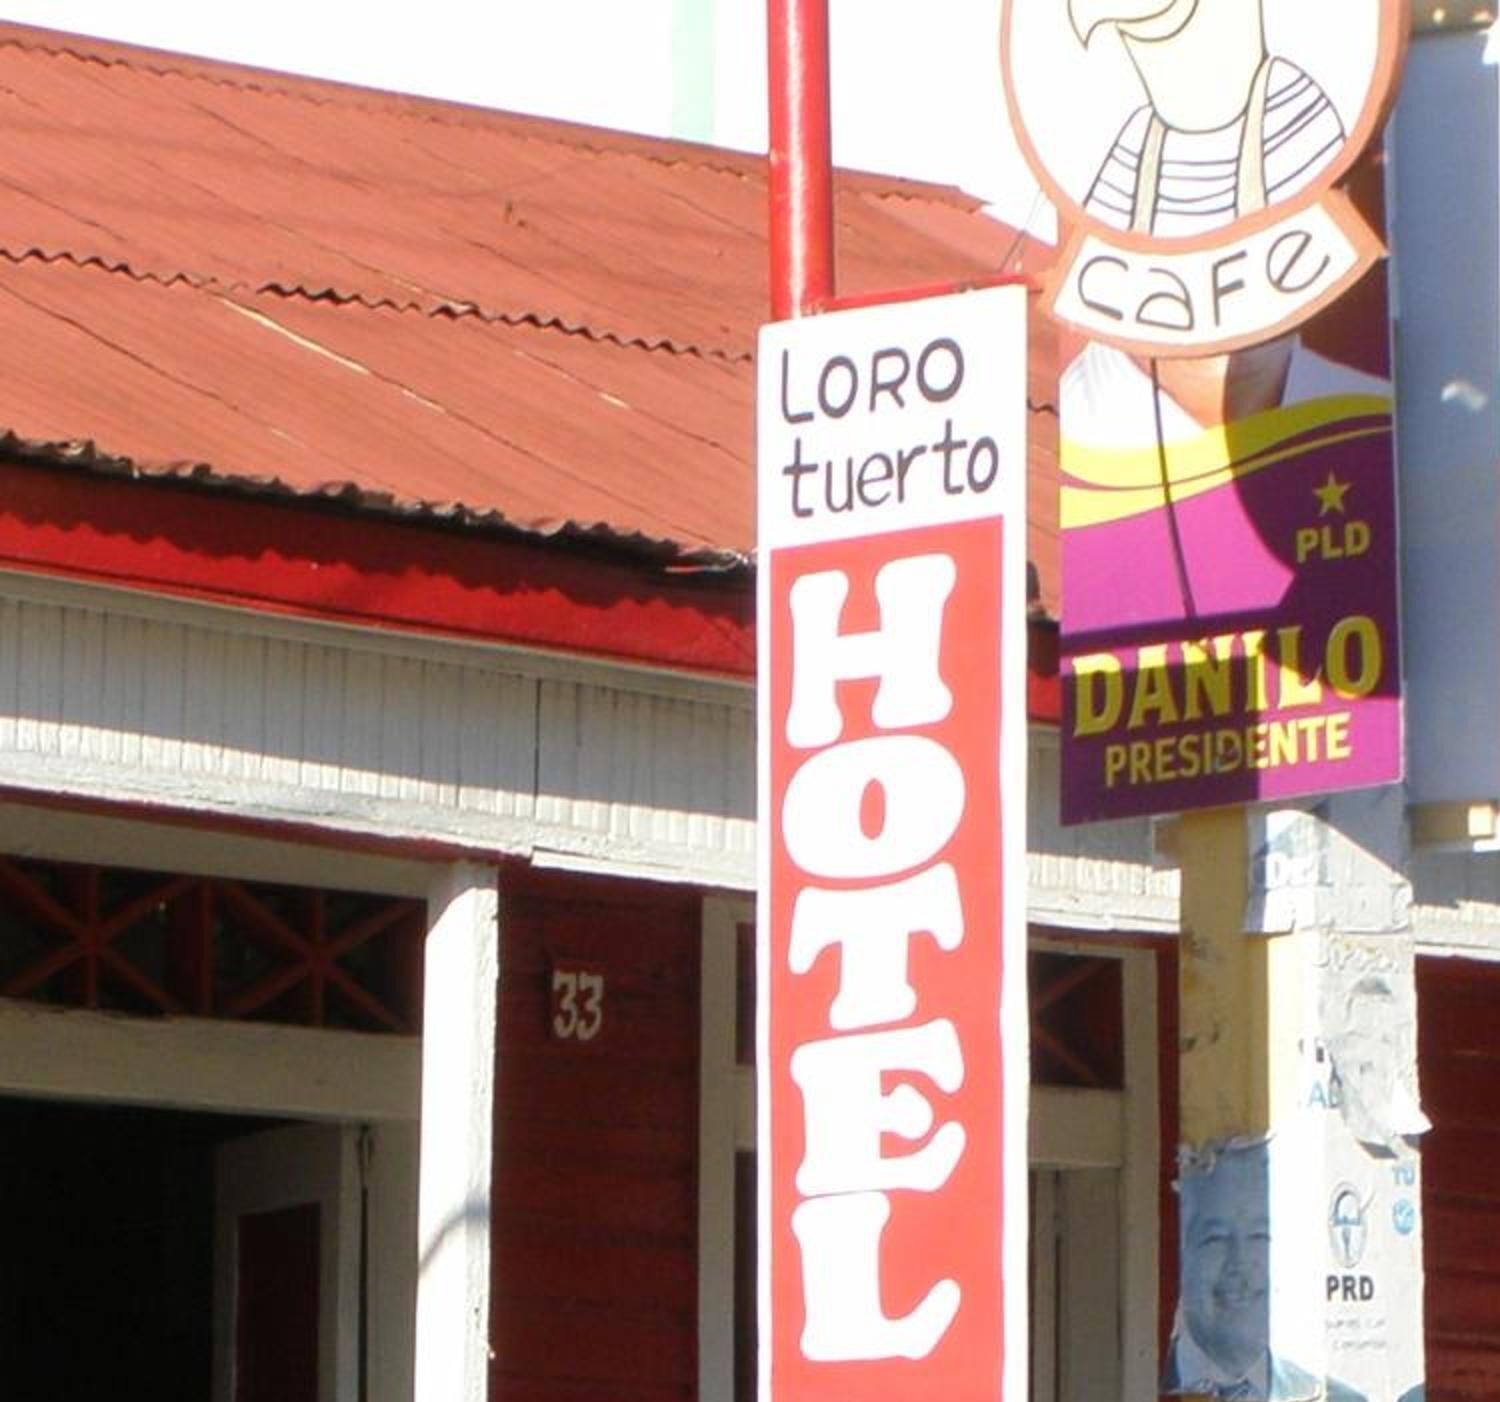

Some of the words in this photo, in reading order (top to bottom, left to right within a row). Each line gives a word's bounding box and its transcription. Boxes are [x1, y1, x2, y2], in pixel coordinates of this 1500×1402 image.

[781, 337, 965, 424] LORO
[782, 418, 999, 518] tuerto
[1296, 521, 1370, 563] PLD
[1072, 615, 1382, 737] DANILO
[1105, 712, 1351, 788] PRESIDENTE
[782, 552, 966, 1361] HOTEL
[552, 968, 604, 1041] 33
[1326, 1274, 1375, 1302] PRD
